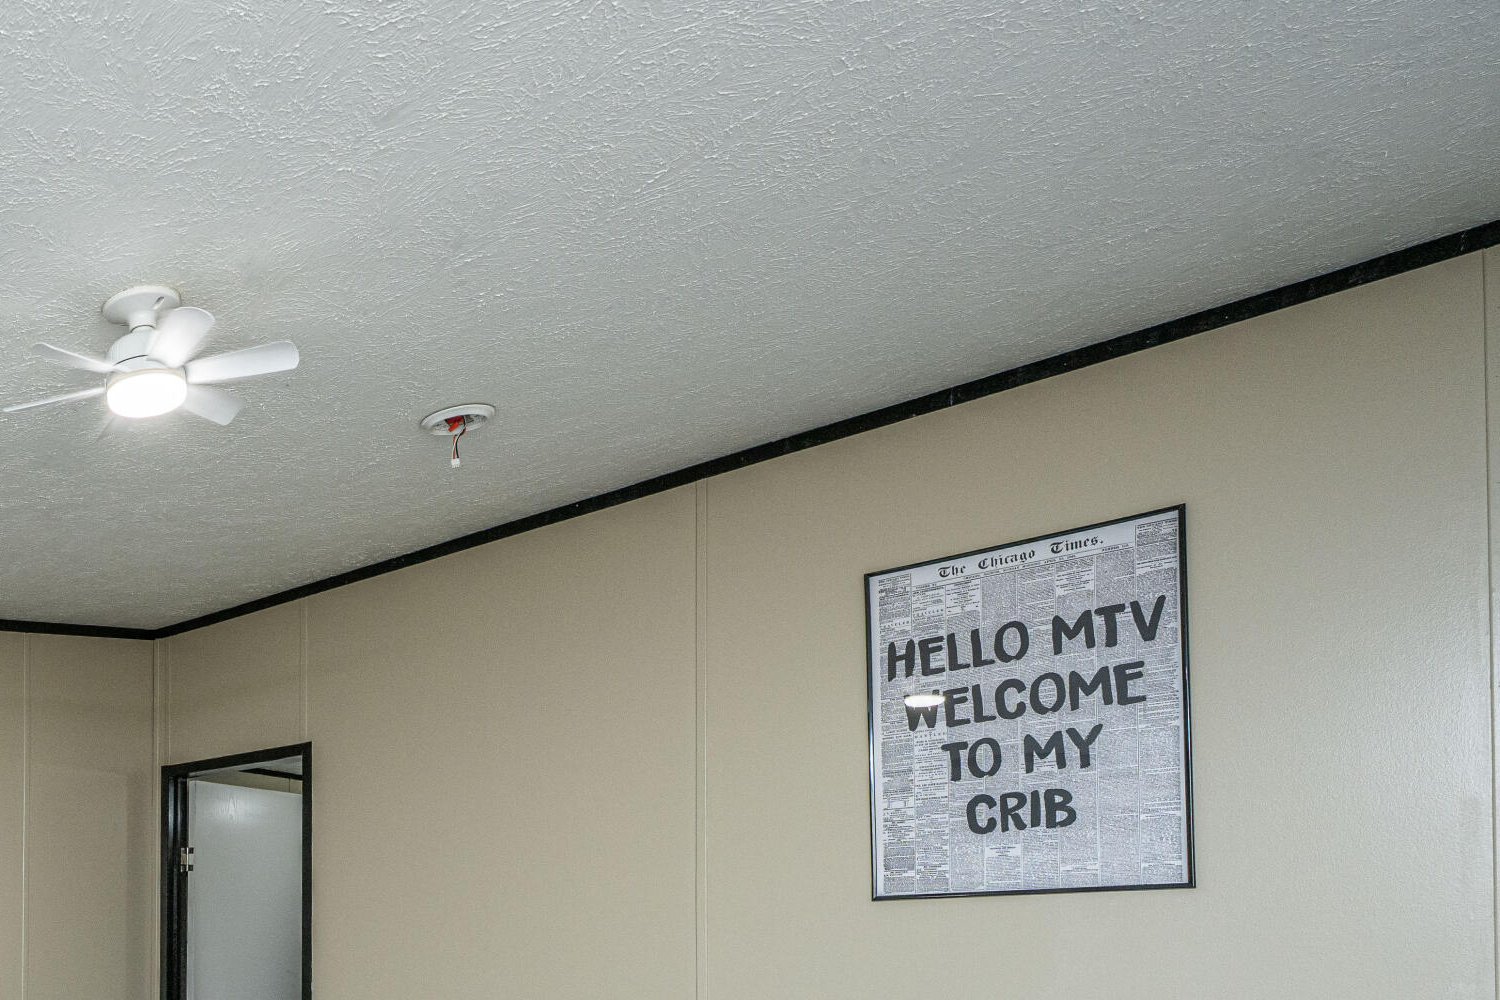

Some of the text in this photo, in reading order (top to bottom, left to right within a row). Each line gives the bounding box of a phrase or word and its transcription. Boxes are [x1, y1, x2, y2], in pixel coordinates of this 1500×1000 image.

[938, 564, 966, 578] The
[978, 548, 1036, 571] Chicago
[1050, 536, 1104, 554] Times.
[887, 620, 1030, 682] HELLO
[1051, 595, 1166, 656] MTV
[904, 660, 1146, 732] WELCOME
[941, 737, 1002, 782] TO
[1024, 723, 1104, 774] MY
[966, 788, 1078, 835] CRIB
